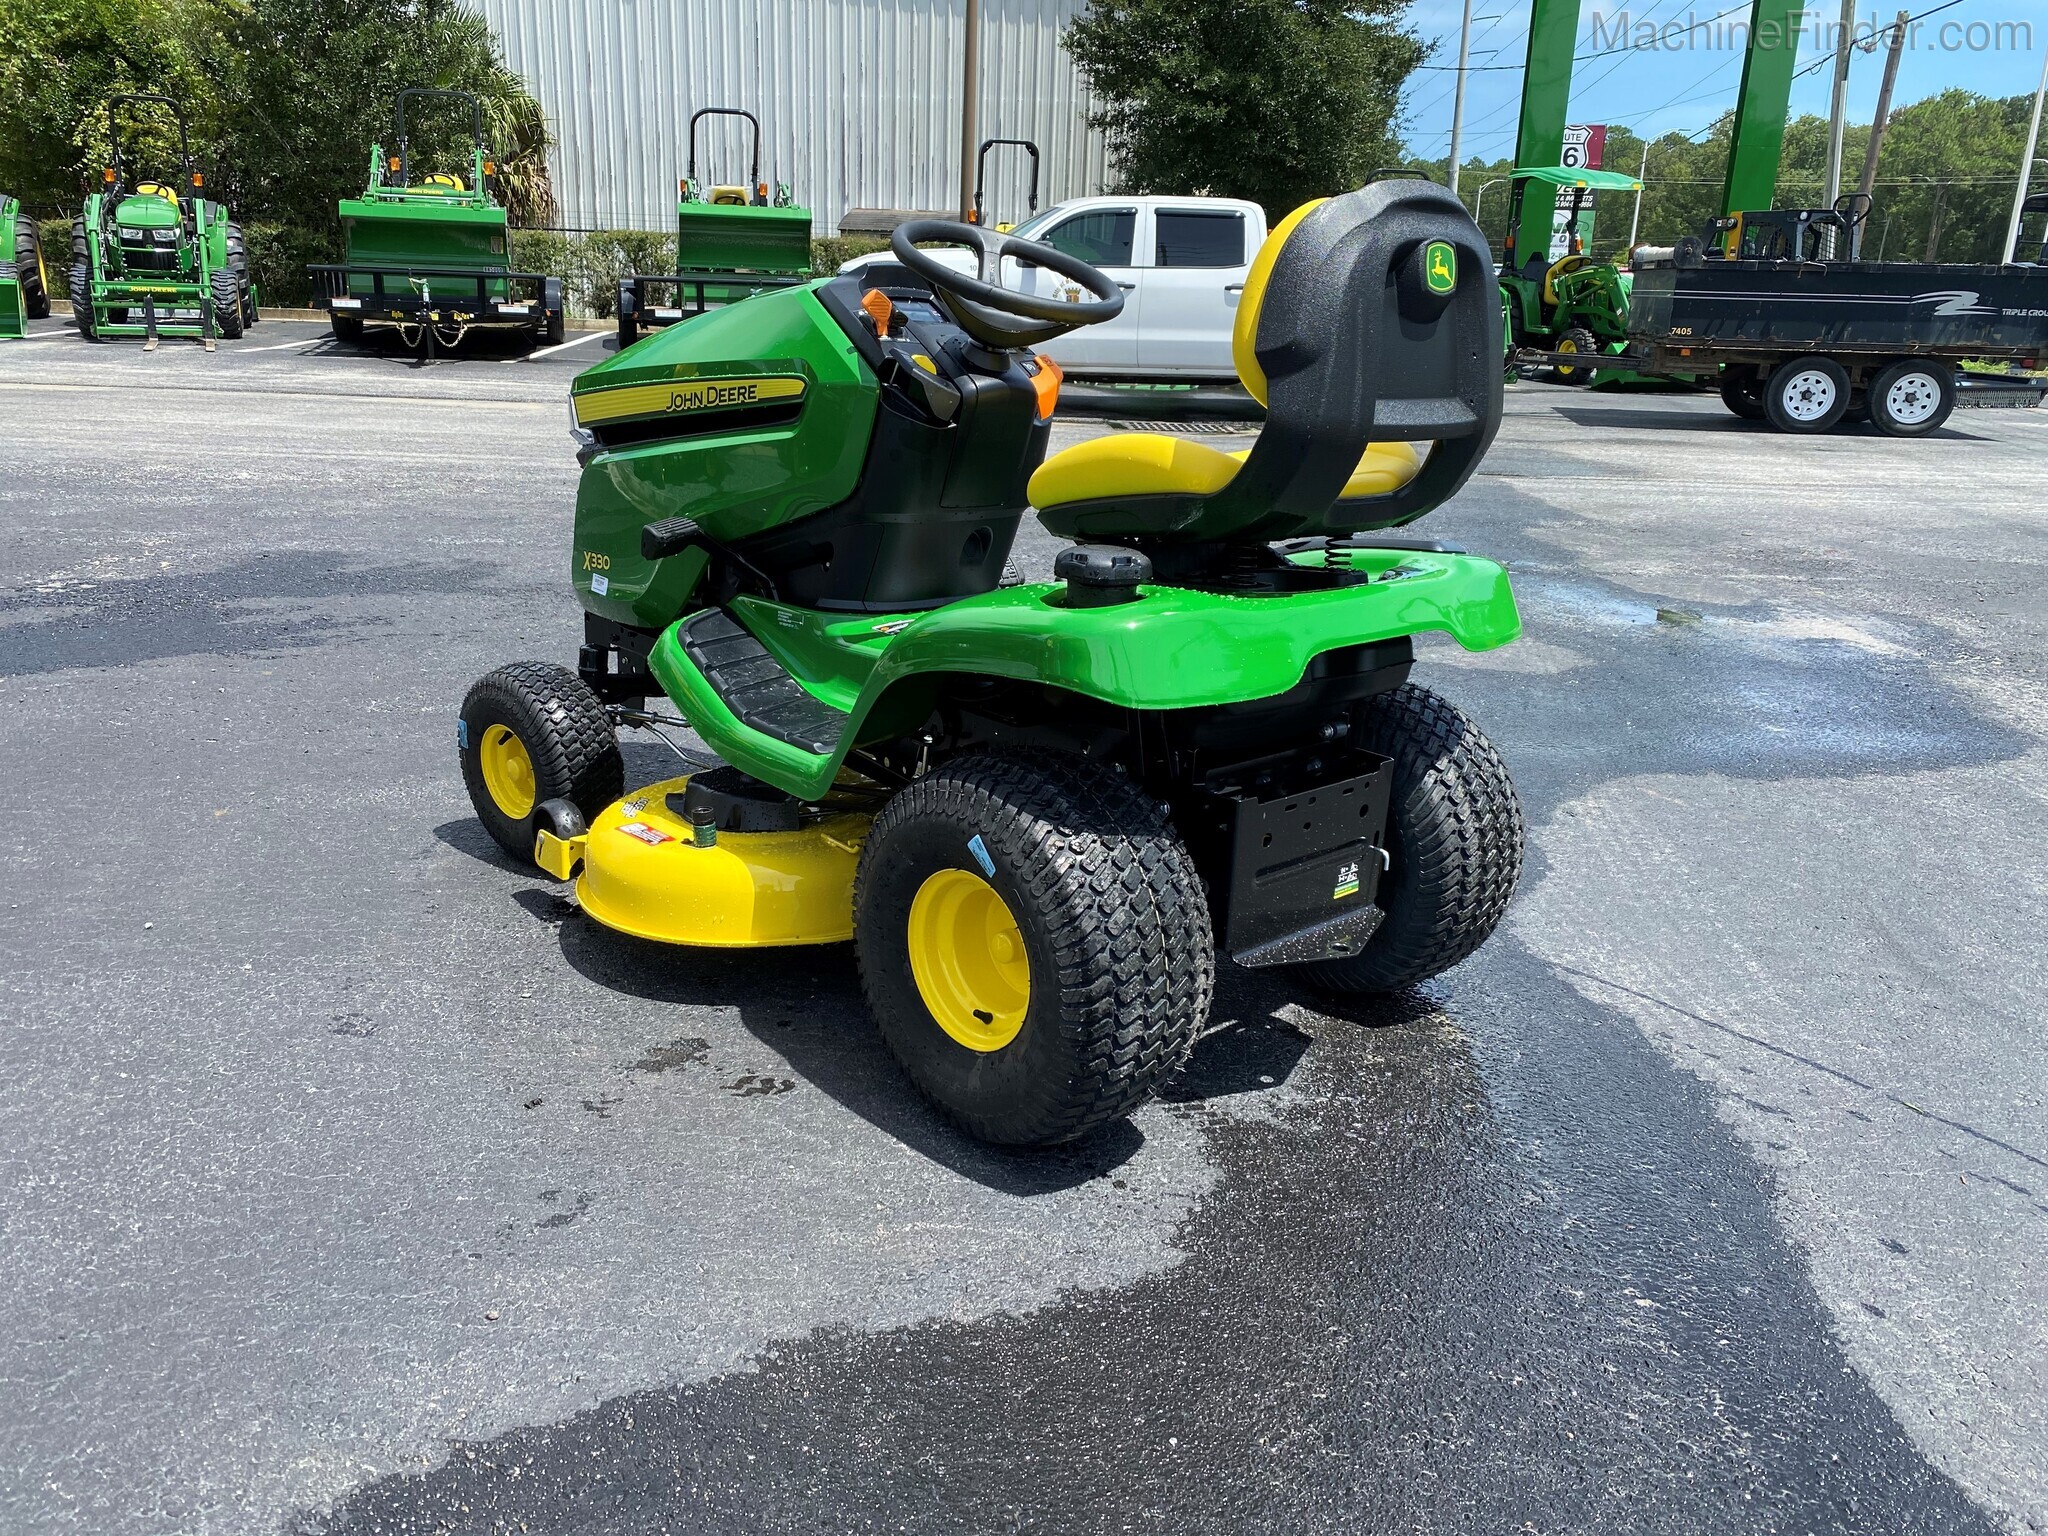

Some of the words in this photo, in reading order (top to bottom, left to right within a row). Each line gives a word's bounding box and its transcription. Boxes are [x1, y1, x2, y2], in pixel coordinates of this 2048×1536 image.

[1565, 133, 1582, 141] UTE
[1562, 147, 1579, 167] 6
[2001, 308, 2028, 316] TRIPLE
[1671, 327, 1693, 335] 7405
[666, 391, 705, 411] JOHN
[706, 384, 758, 407] DEERE
[582, 550, 611, 571] X330
